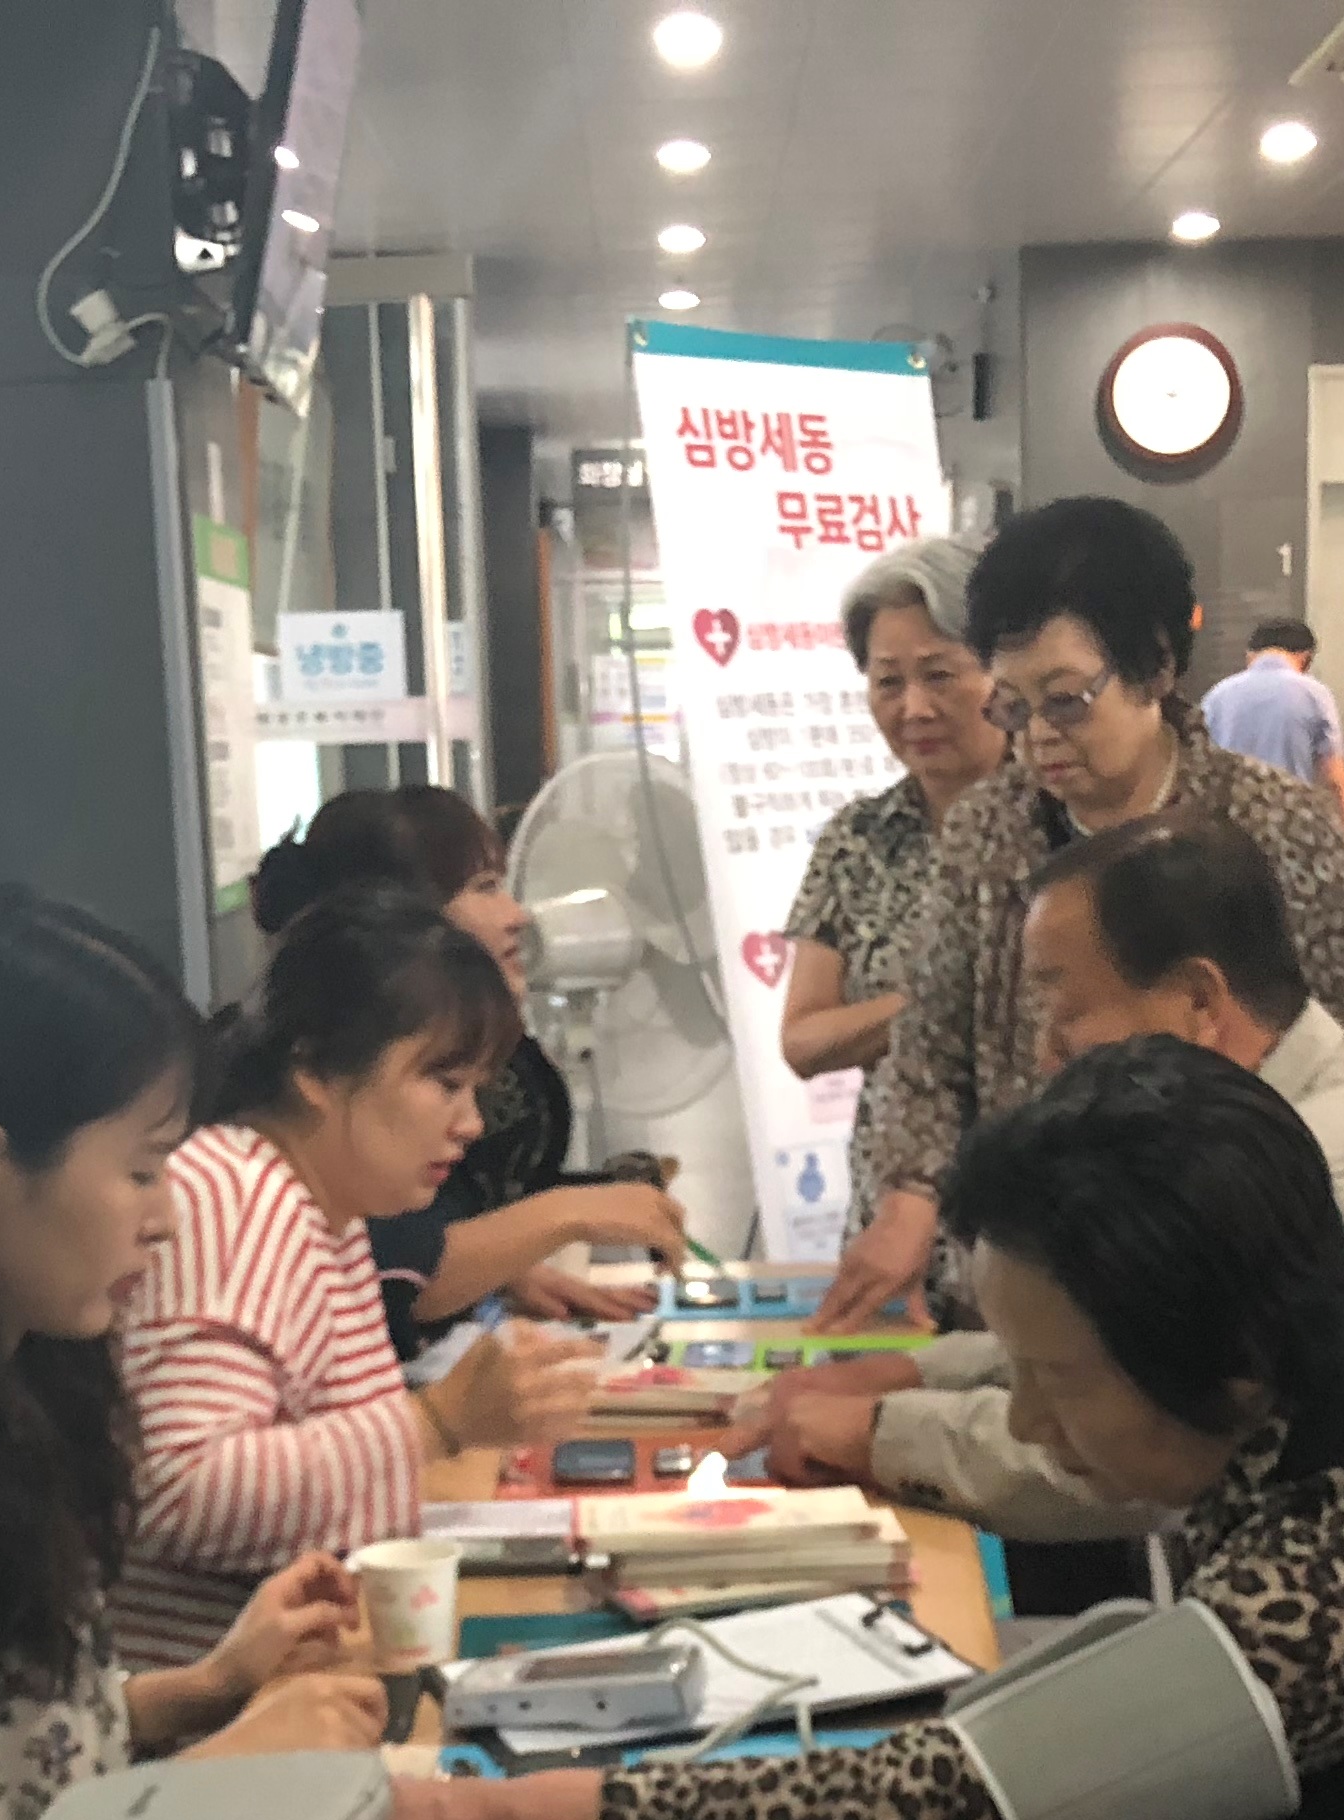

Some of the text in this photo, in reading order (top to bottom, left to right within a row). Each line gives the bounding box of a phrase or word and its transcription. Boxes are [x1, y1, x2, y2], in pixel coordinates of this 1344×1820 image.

[676, 405, 834, 475] 심방세동
[775, 489, 922, 552] 무료검사
[1276, 542, 1293, 577] 1
